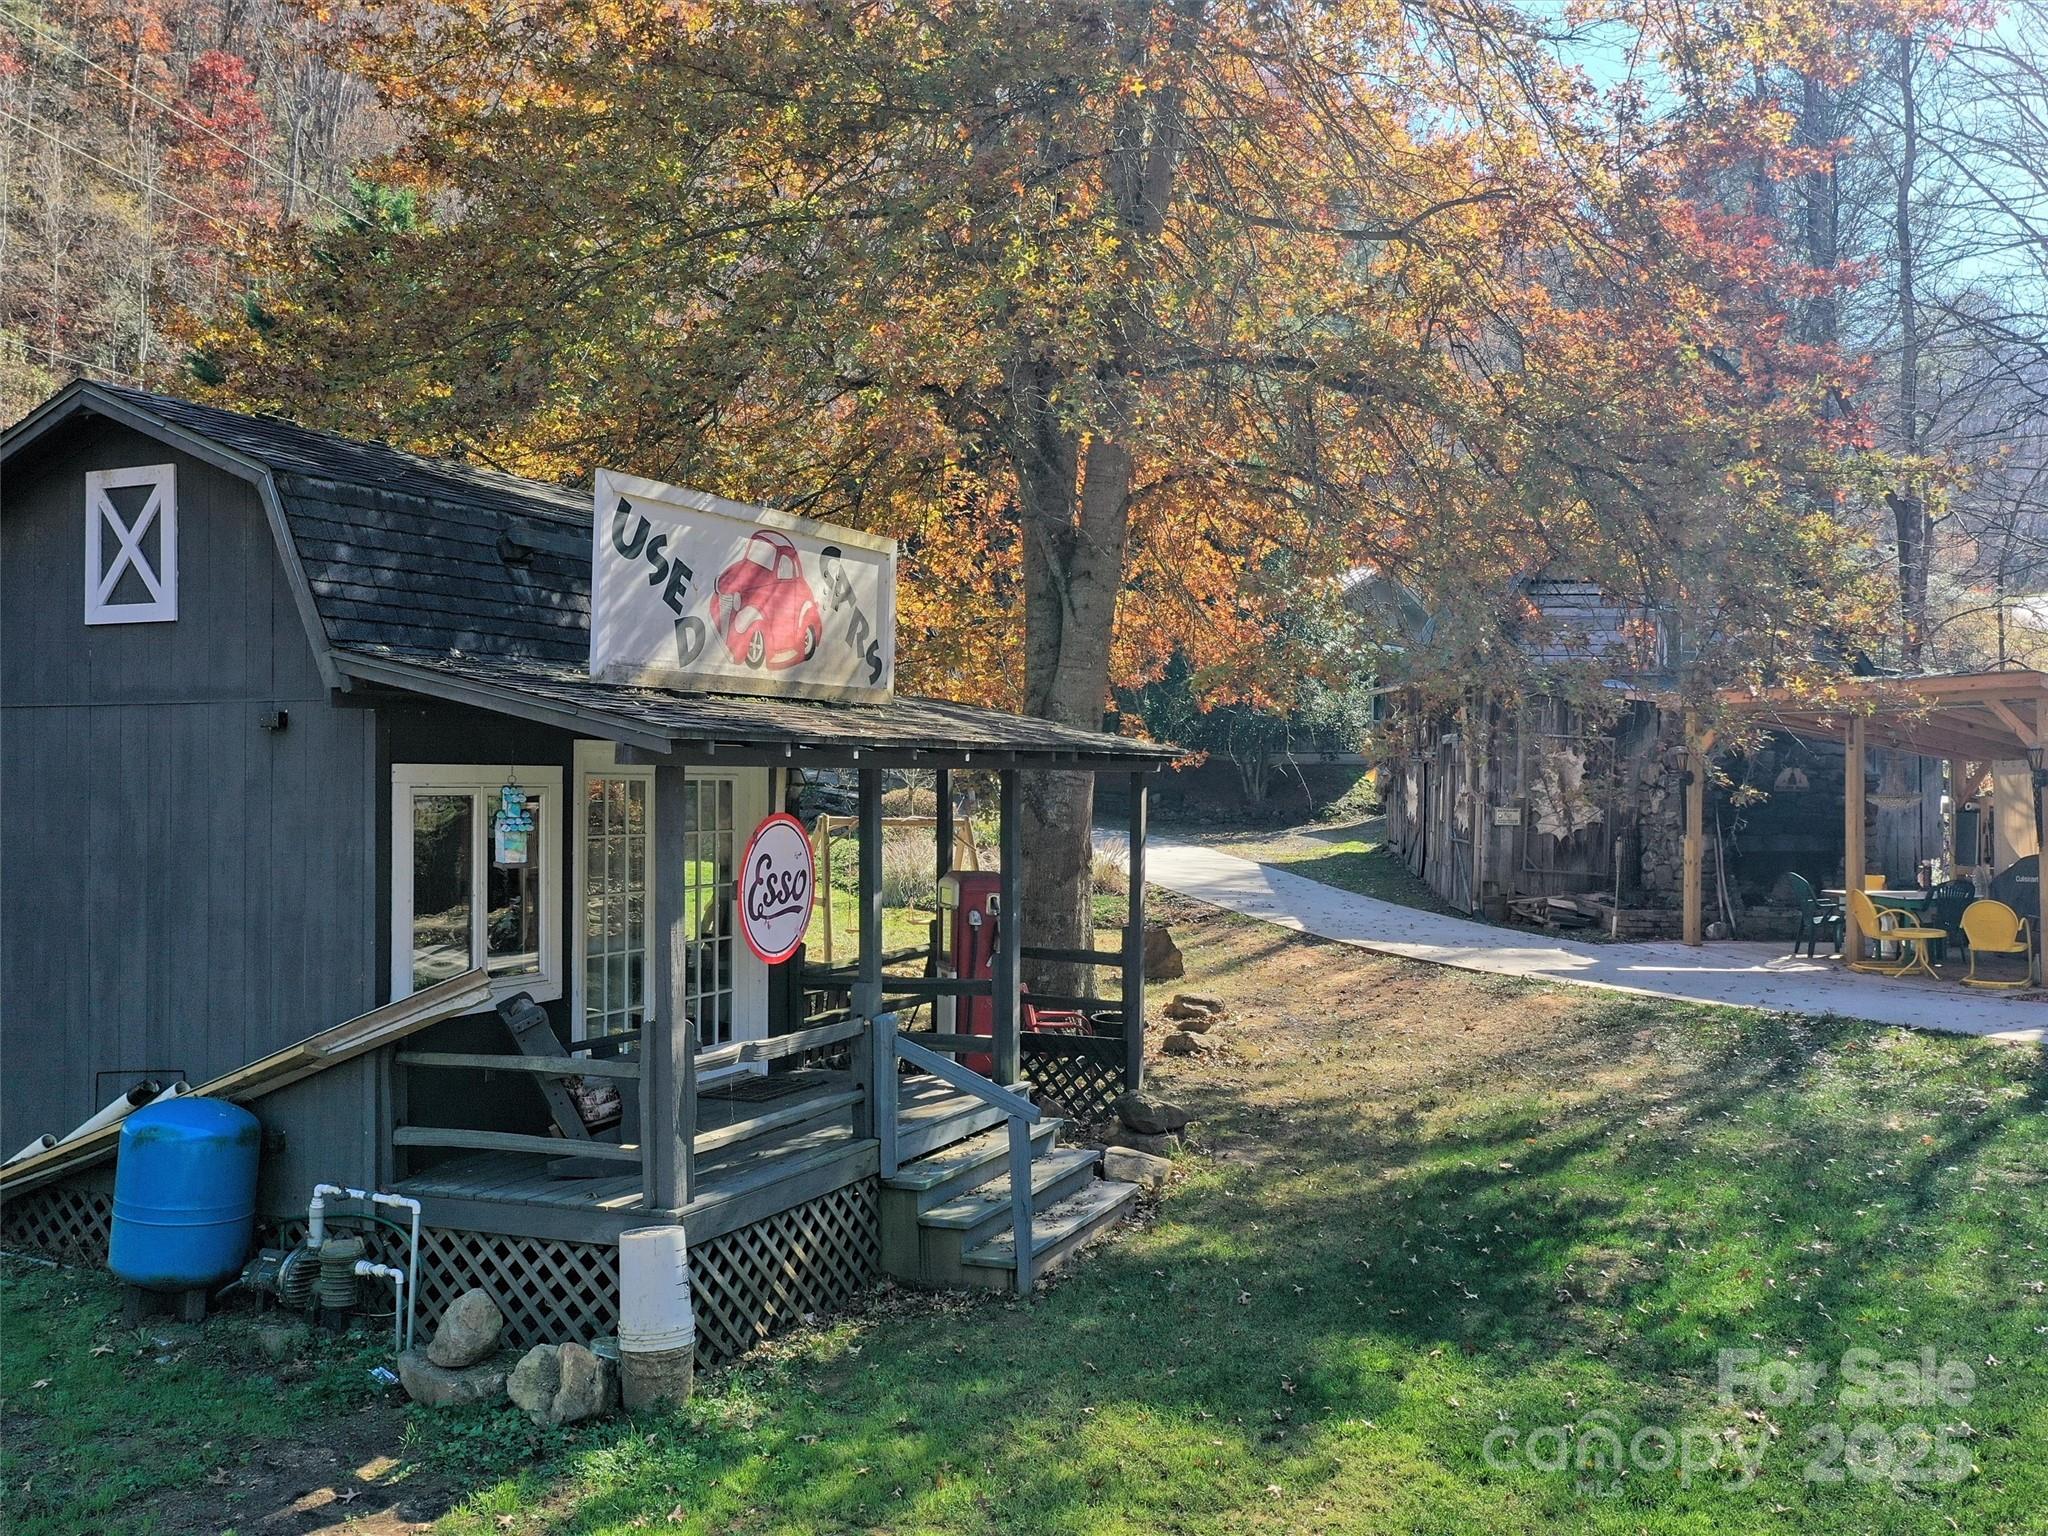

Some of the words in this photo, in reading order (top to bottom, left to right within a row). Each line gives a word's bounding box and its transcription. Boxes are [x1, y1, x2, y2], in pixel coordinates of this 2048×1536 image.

[612, 497, 706, 668] USED
[819, 546, 882, 685] CARS
[748, 853, 807, 922] Esso
